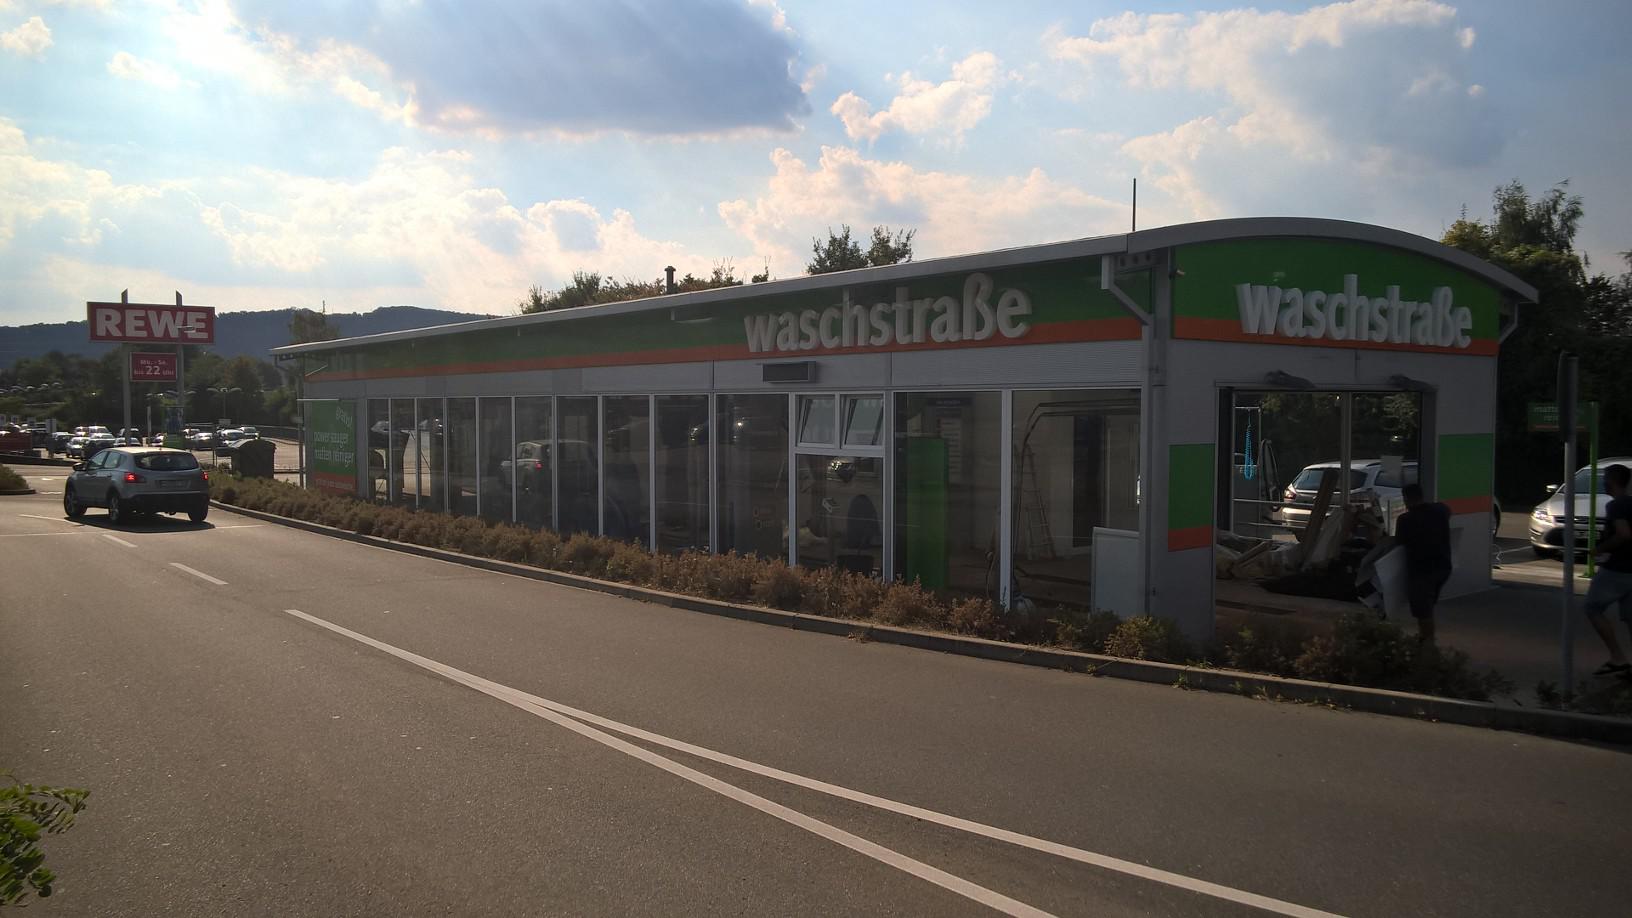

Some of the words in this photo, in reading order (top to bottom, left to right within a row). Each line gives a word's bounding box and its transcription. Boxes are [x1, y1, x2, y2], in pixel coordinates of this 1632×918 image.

[95, 308, 209, 339] REWE
[743, 272, 1033, 353] waschstraße
[1236, 273, 1473, 349] waschstraße
[145, 365, 161, 375] 22
